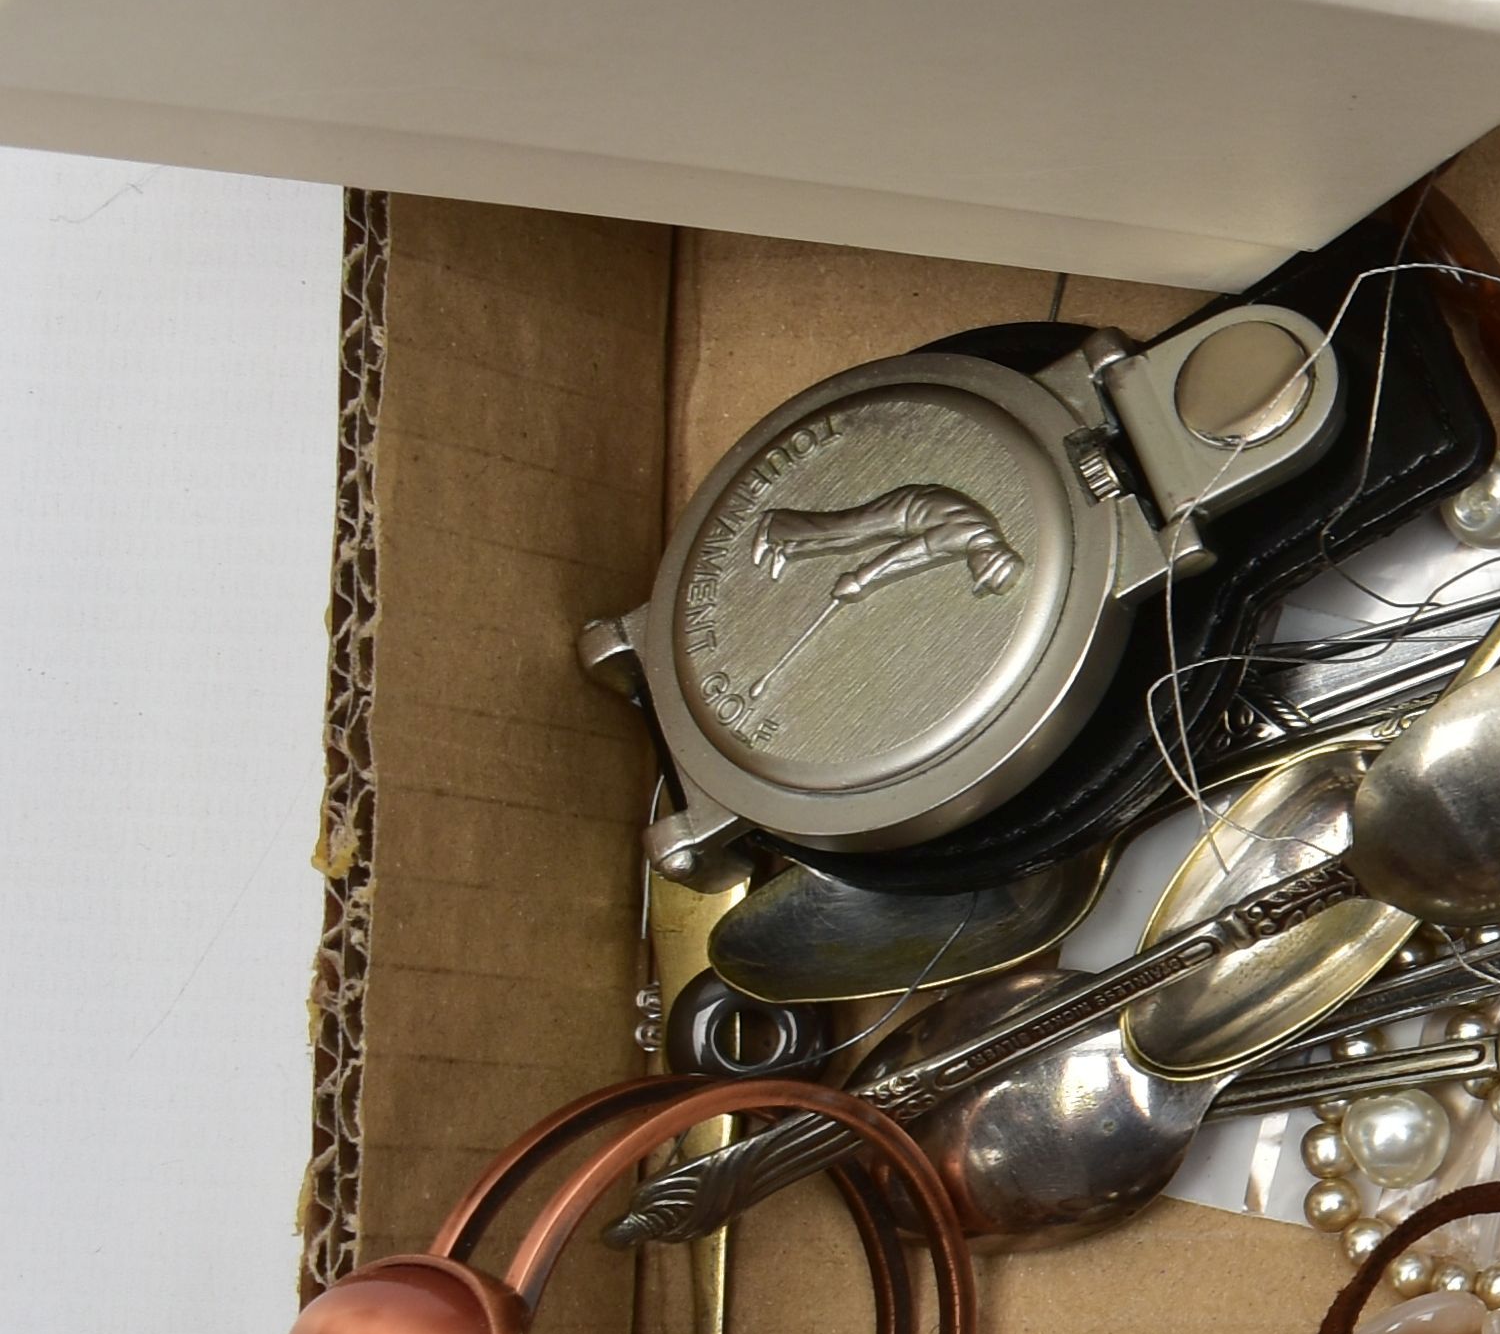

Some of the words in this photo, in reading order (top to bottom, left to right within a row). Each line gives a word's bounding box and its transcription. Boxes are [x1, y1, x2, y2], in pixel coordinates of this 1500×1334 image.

[684, 416, 843, 655] TOURNAMENT
[700, 671, 780, 748] GOLF
[1094, 954, 1186, 1006] STAINLESS
[1031, 1000, 1093, 1035] NICKEL
[970, 1031, 1032, 1066] SILVER
